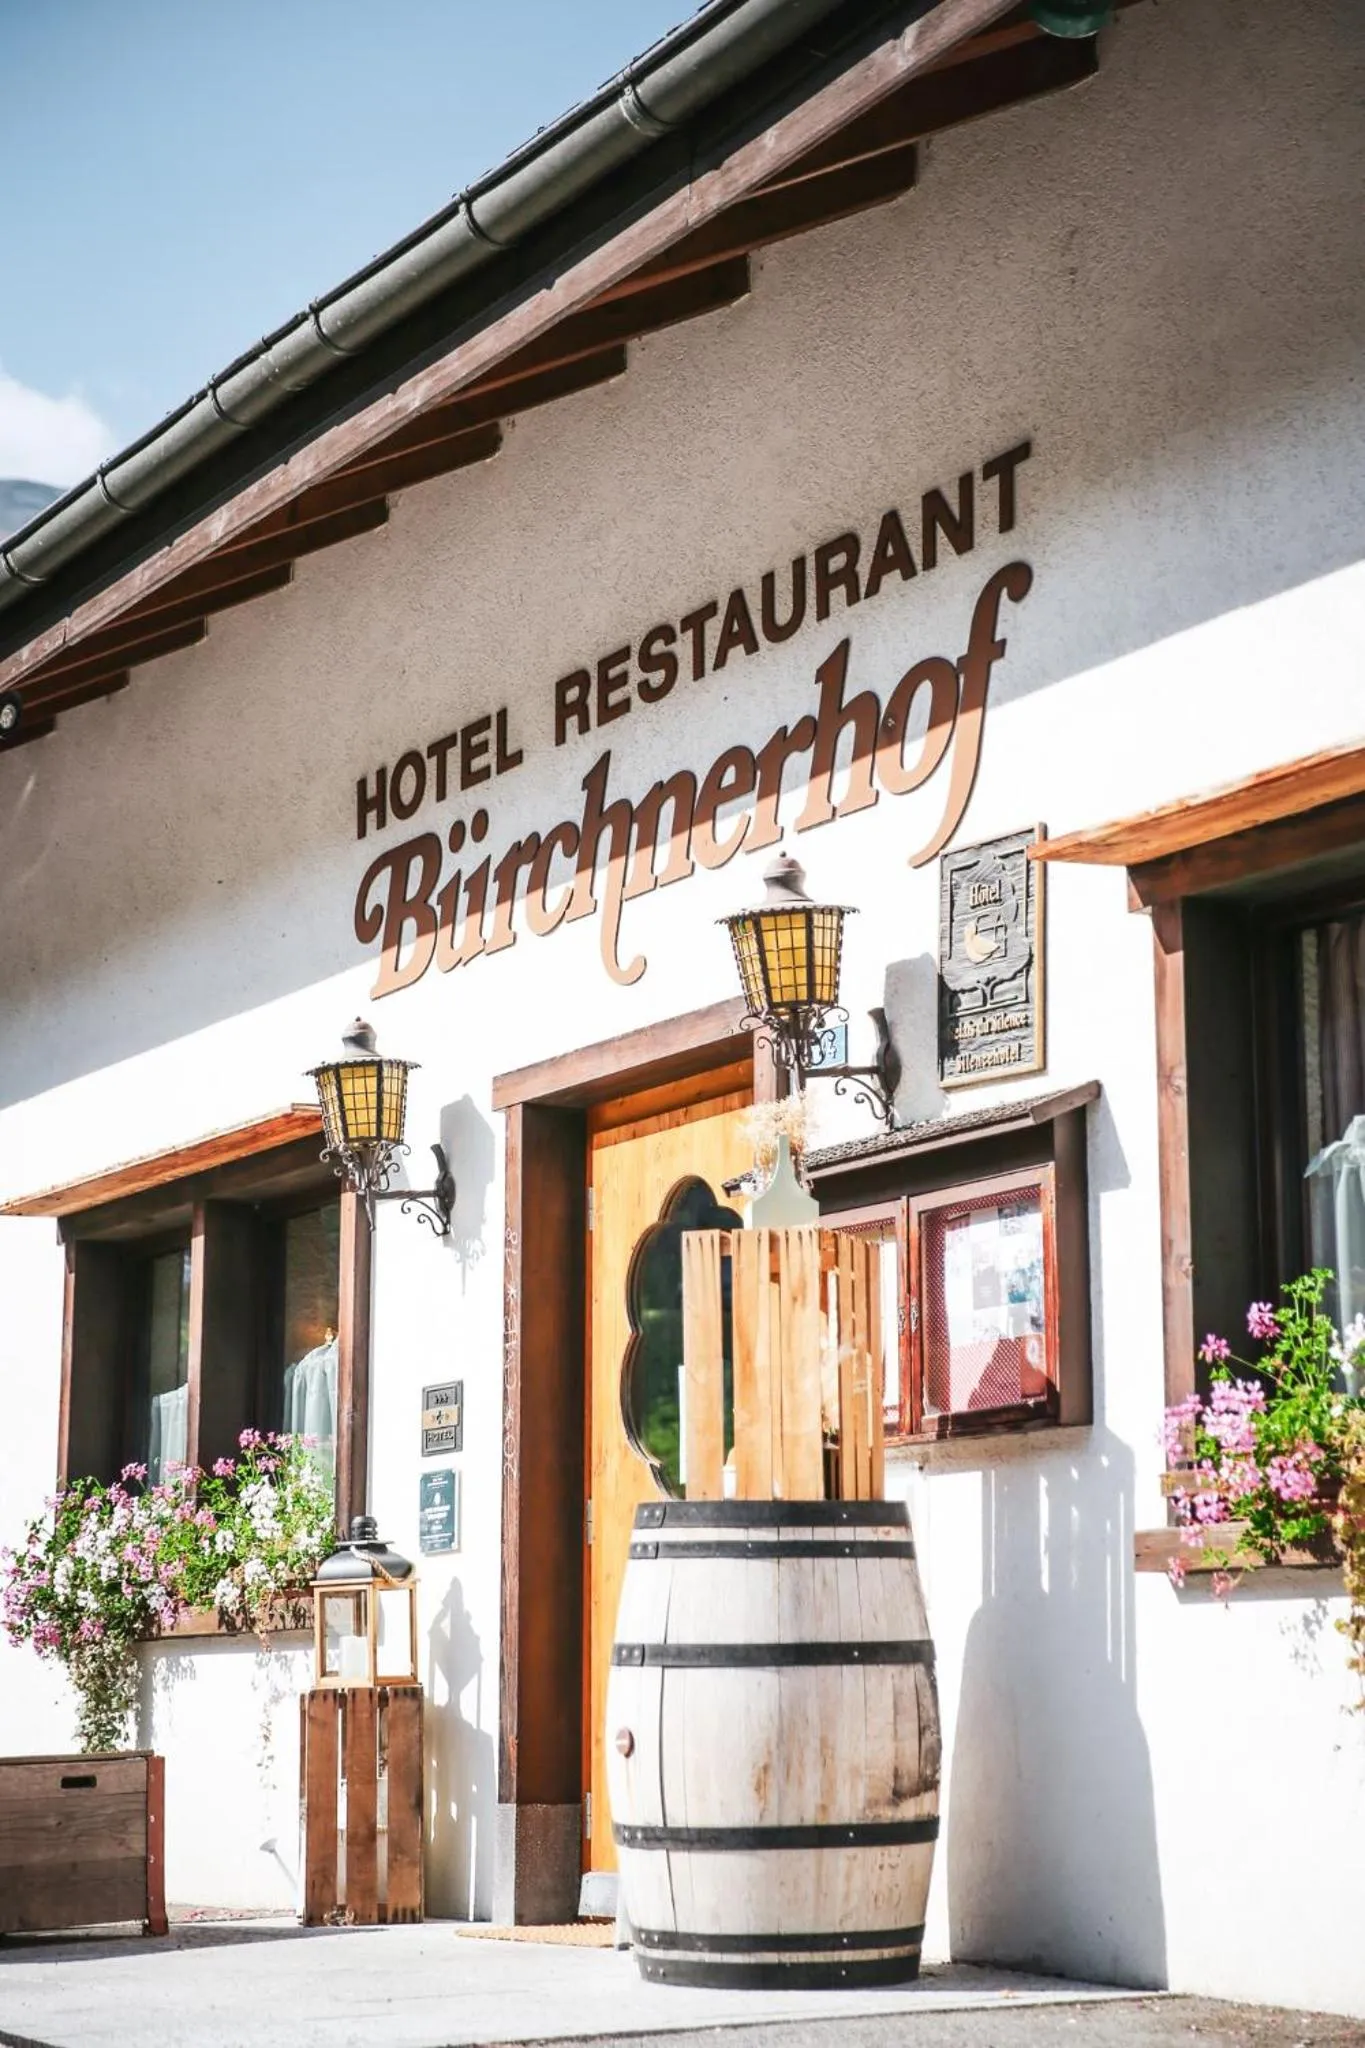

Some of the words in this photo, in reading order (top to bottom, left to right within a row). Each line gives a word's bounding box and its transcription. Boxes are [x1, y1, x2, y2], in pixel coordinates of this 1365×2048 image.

[357, 708, 523, 839] HOTEL
[555, 442, 1031, 746] RESTAURANT
[354, 562, 1032, 1001] Bürchnerhof
[969, 880, 1003, 909] Hotel
[428, 1430, 454, 1443] HOTEL
